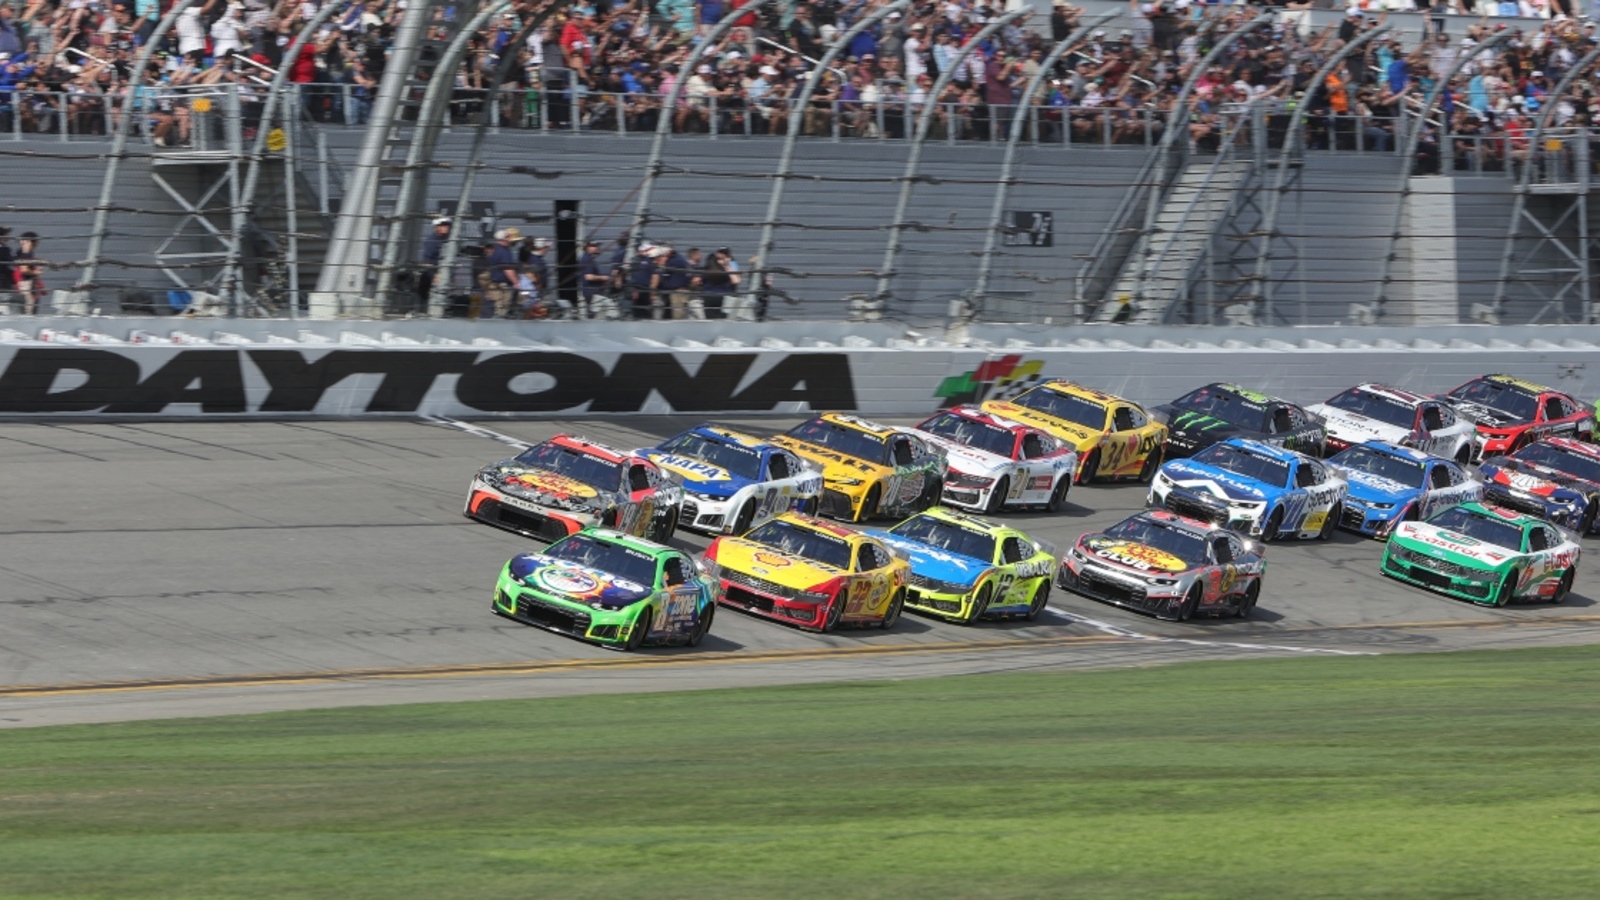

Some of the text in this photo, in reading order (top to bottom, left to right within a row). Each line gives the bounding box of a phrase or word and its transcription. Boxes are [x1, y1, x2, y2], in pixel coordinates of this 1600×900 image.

[0, 348, 857, 413] DAYTONA
[1101, 441, 1126, 471] 34
[1166, 438, 1194, 450] AMRY
[659, 454, 720, 478] NAPA
[1167, 462, 1253, 491] Spectrum
[1009, 467, 1030, 499] 21
[991, 574, 1014, 604] 12
